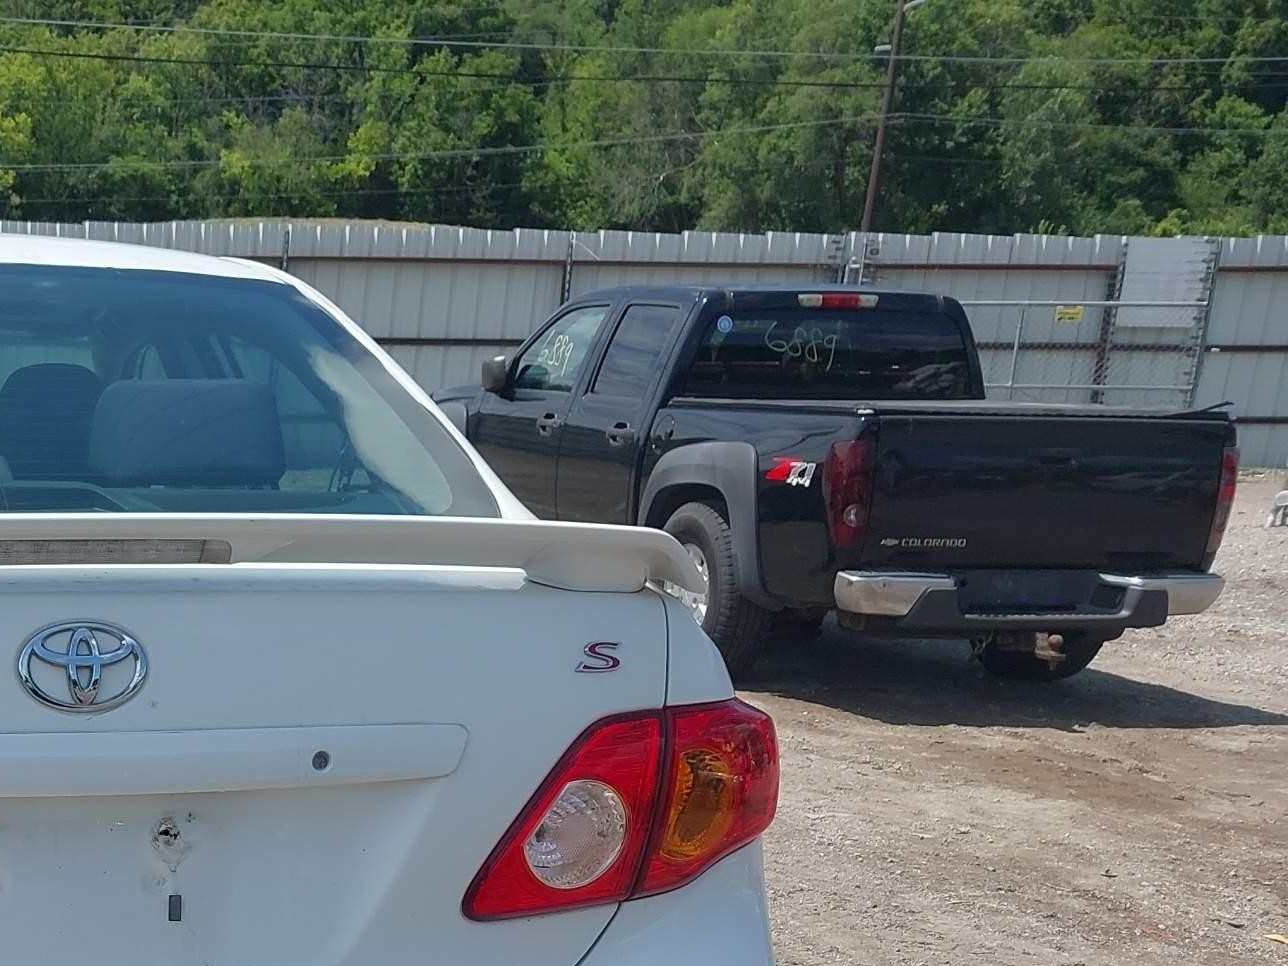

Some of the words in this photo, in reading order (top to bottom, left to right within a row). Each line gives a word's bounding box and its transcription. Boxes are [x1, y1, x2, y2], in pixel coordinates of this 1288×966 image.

[764, 320, 837, 373] 6889
[901, 538, 967, 547] COLORADO
[574, 641, 622, 674] S
